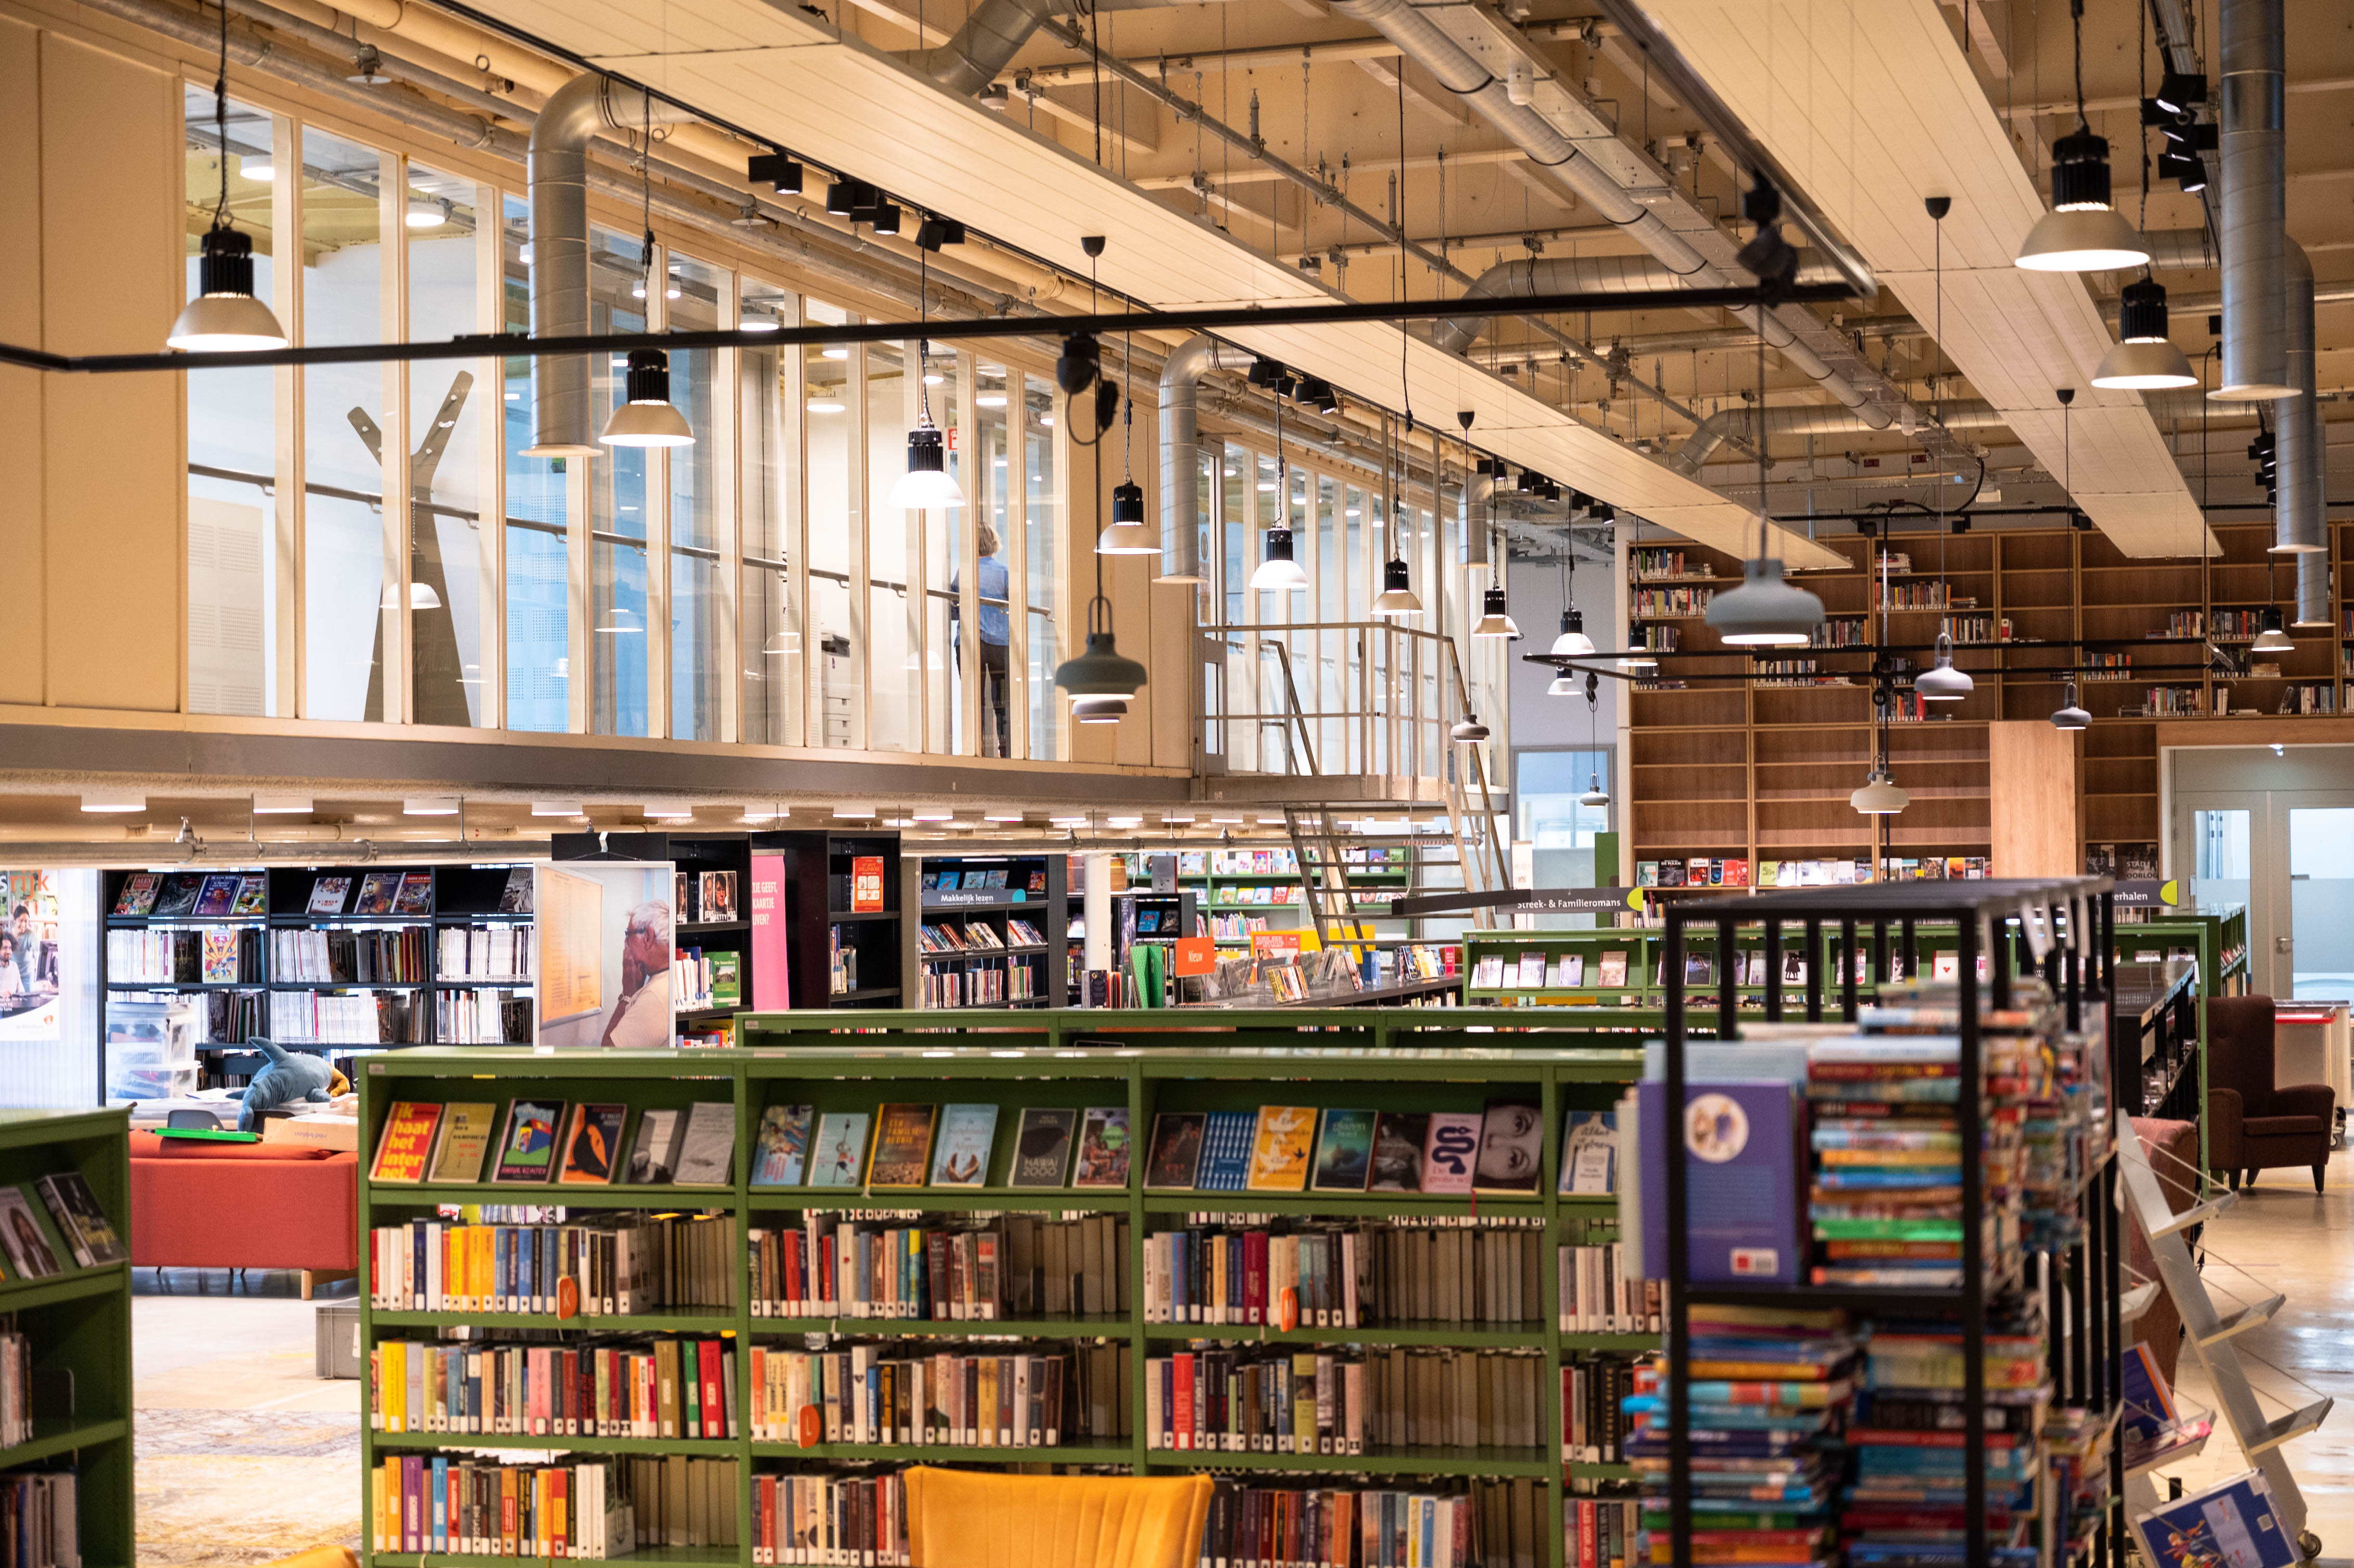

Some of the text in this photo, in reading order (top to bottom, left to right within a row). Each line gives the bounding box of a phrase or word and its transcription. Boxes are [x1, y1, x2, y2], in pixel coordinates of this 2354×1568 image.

[761, 881, 778, 894] GEEFT,
[752, 898, 774, 909] KAARTJE
[941, 894, 974, 904] Makkelijk
[1549, 900, 1556, 908] &
[1558, 899, 1621, 908] Familieromans
[1188, 949, 1203, 963] Nieuw
[396, 1103, 415, 1118] ik
[392, 1119, 430, 1135] haat
[388, 1133, 416, 1149] het
[563, 1288, 570, 1308] K
